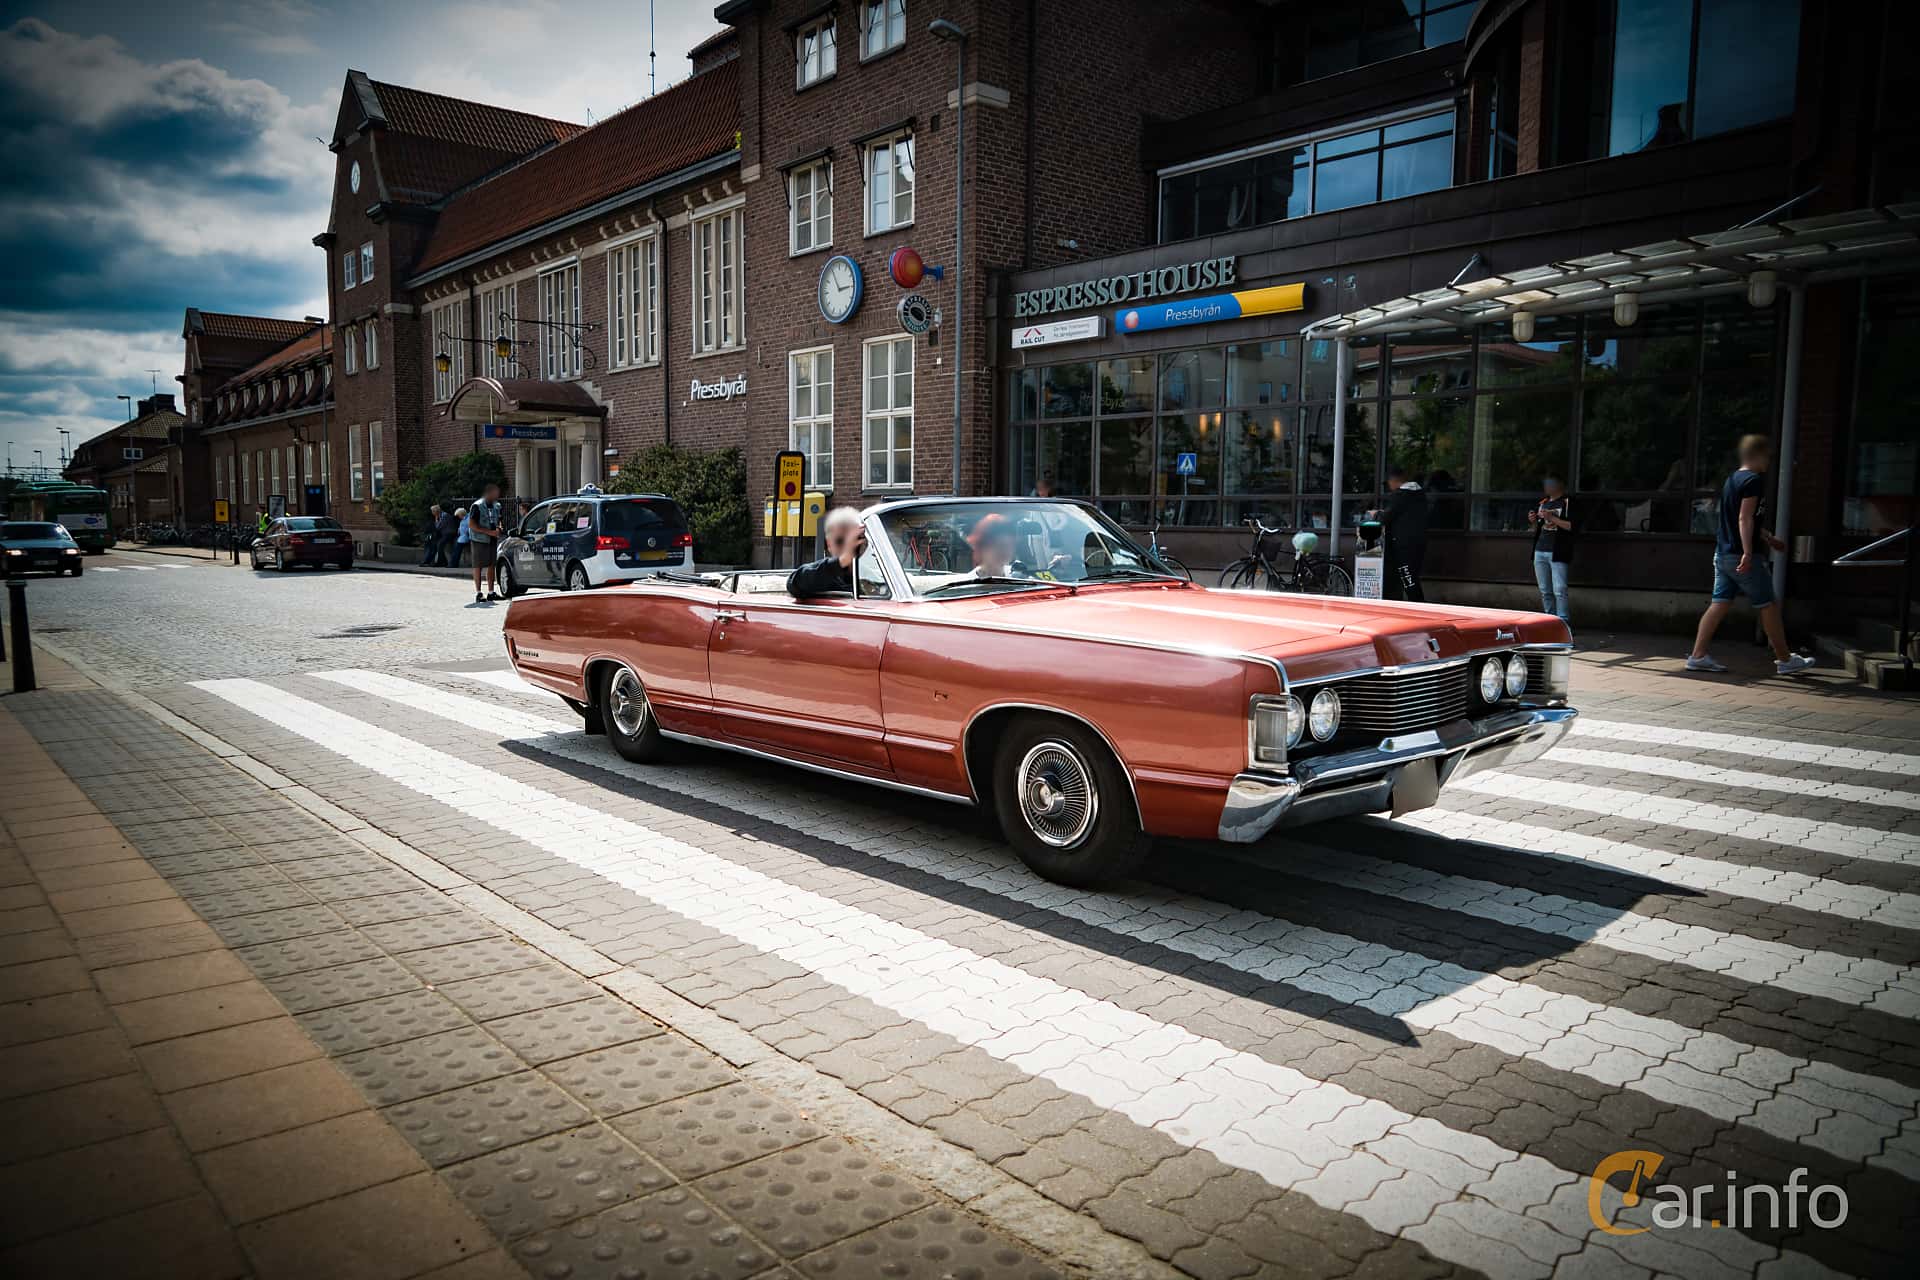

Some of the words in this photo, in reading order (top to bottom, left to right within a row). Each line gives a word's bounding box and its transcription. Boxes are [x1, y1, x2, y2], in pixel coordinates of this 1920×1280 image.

[1014, 275, 1131, 318] ESPRESSO
[1132, 256, 1236, 300] HOUSE
[1165, 302, 1221, 322] Pressbyrån
[1034, 336, 1045, 344] CUT
[783, 460, 800, 468] Taxi-
